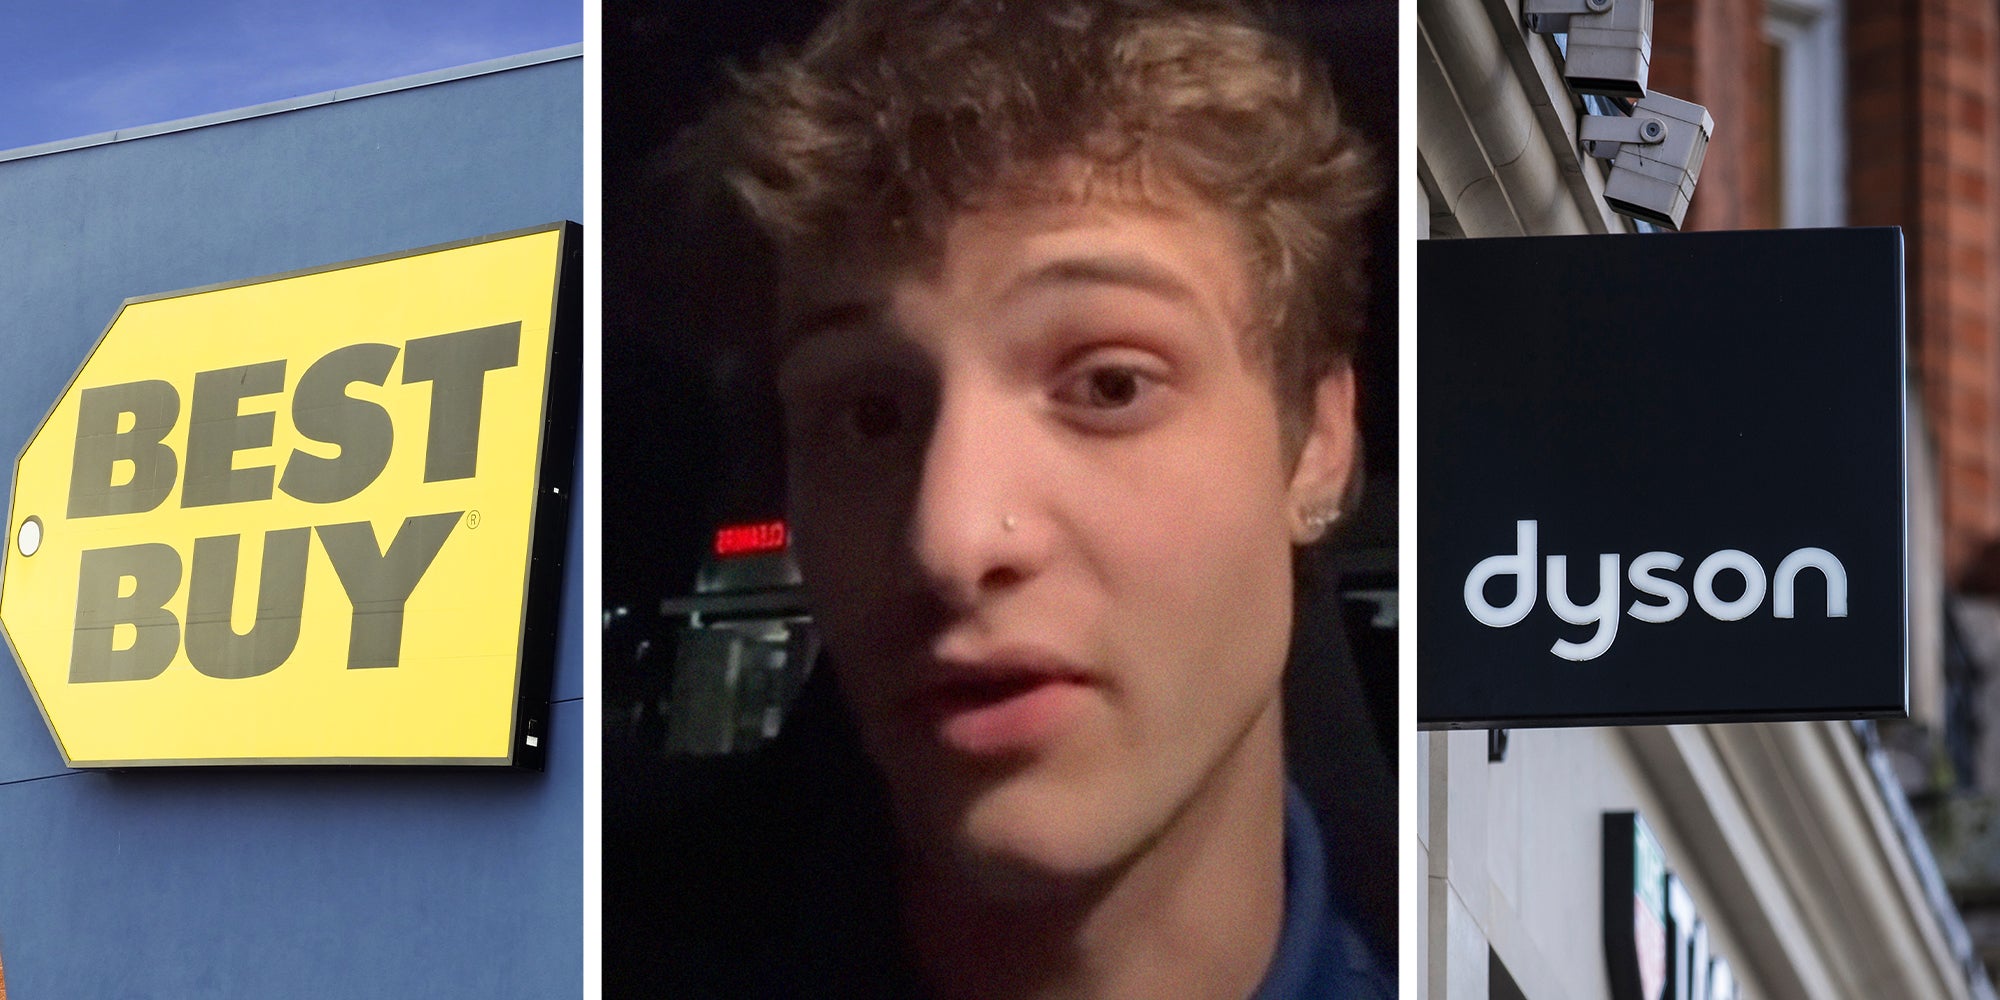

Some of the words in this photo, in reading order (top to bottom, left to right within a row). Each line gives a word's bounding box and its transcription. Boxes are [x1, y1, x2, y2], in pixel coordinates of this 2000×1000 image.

[66, 320, 523, 519] BEST
[67, 510, 466, 685] BUY
[1463, 519, 1848, 662] dyson
